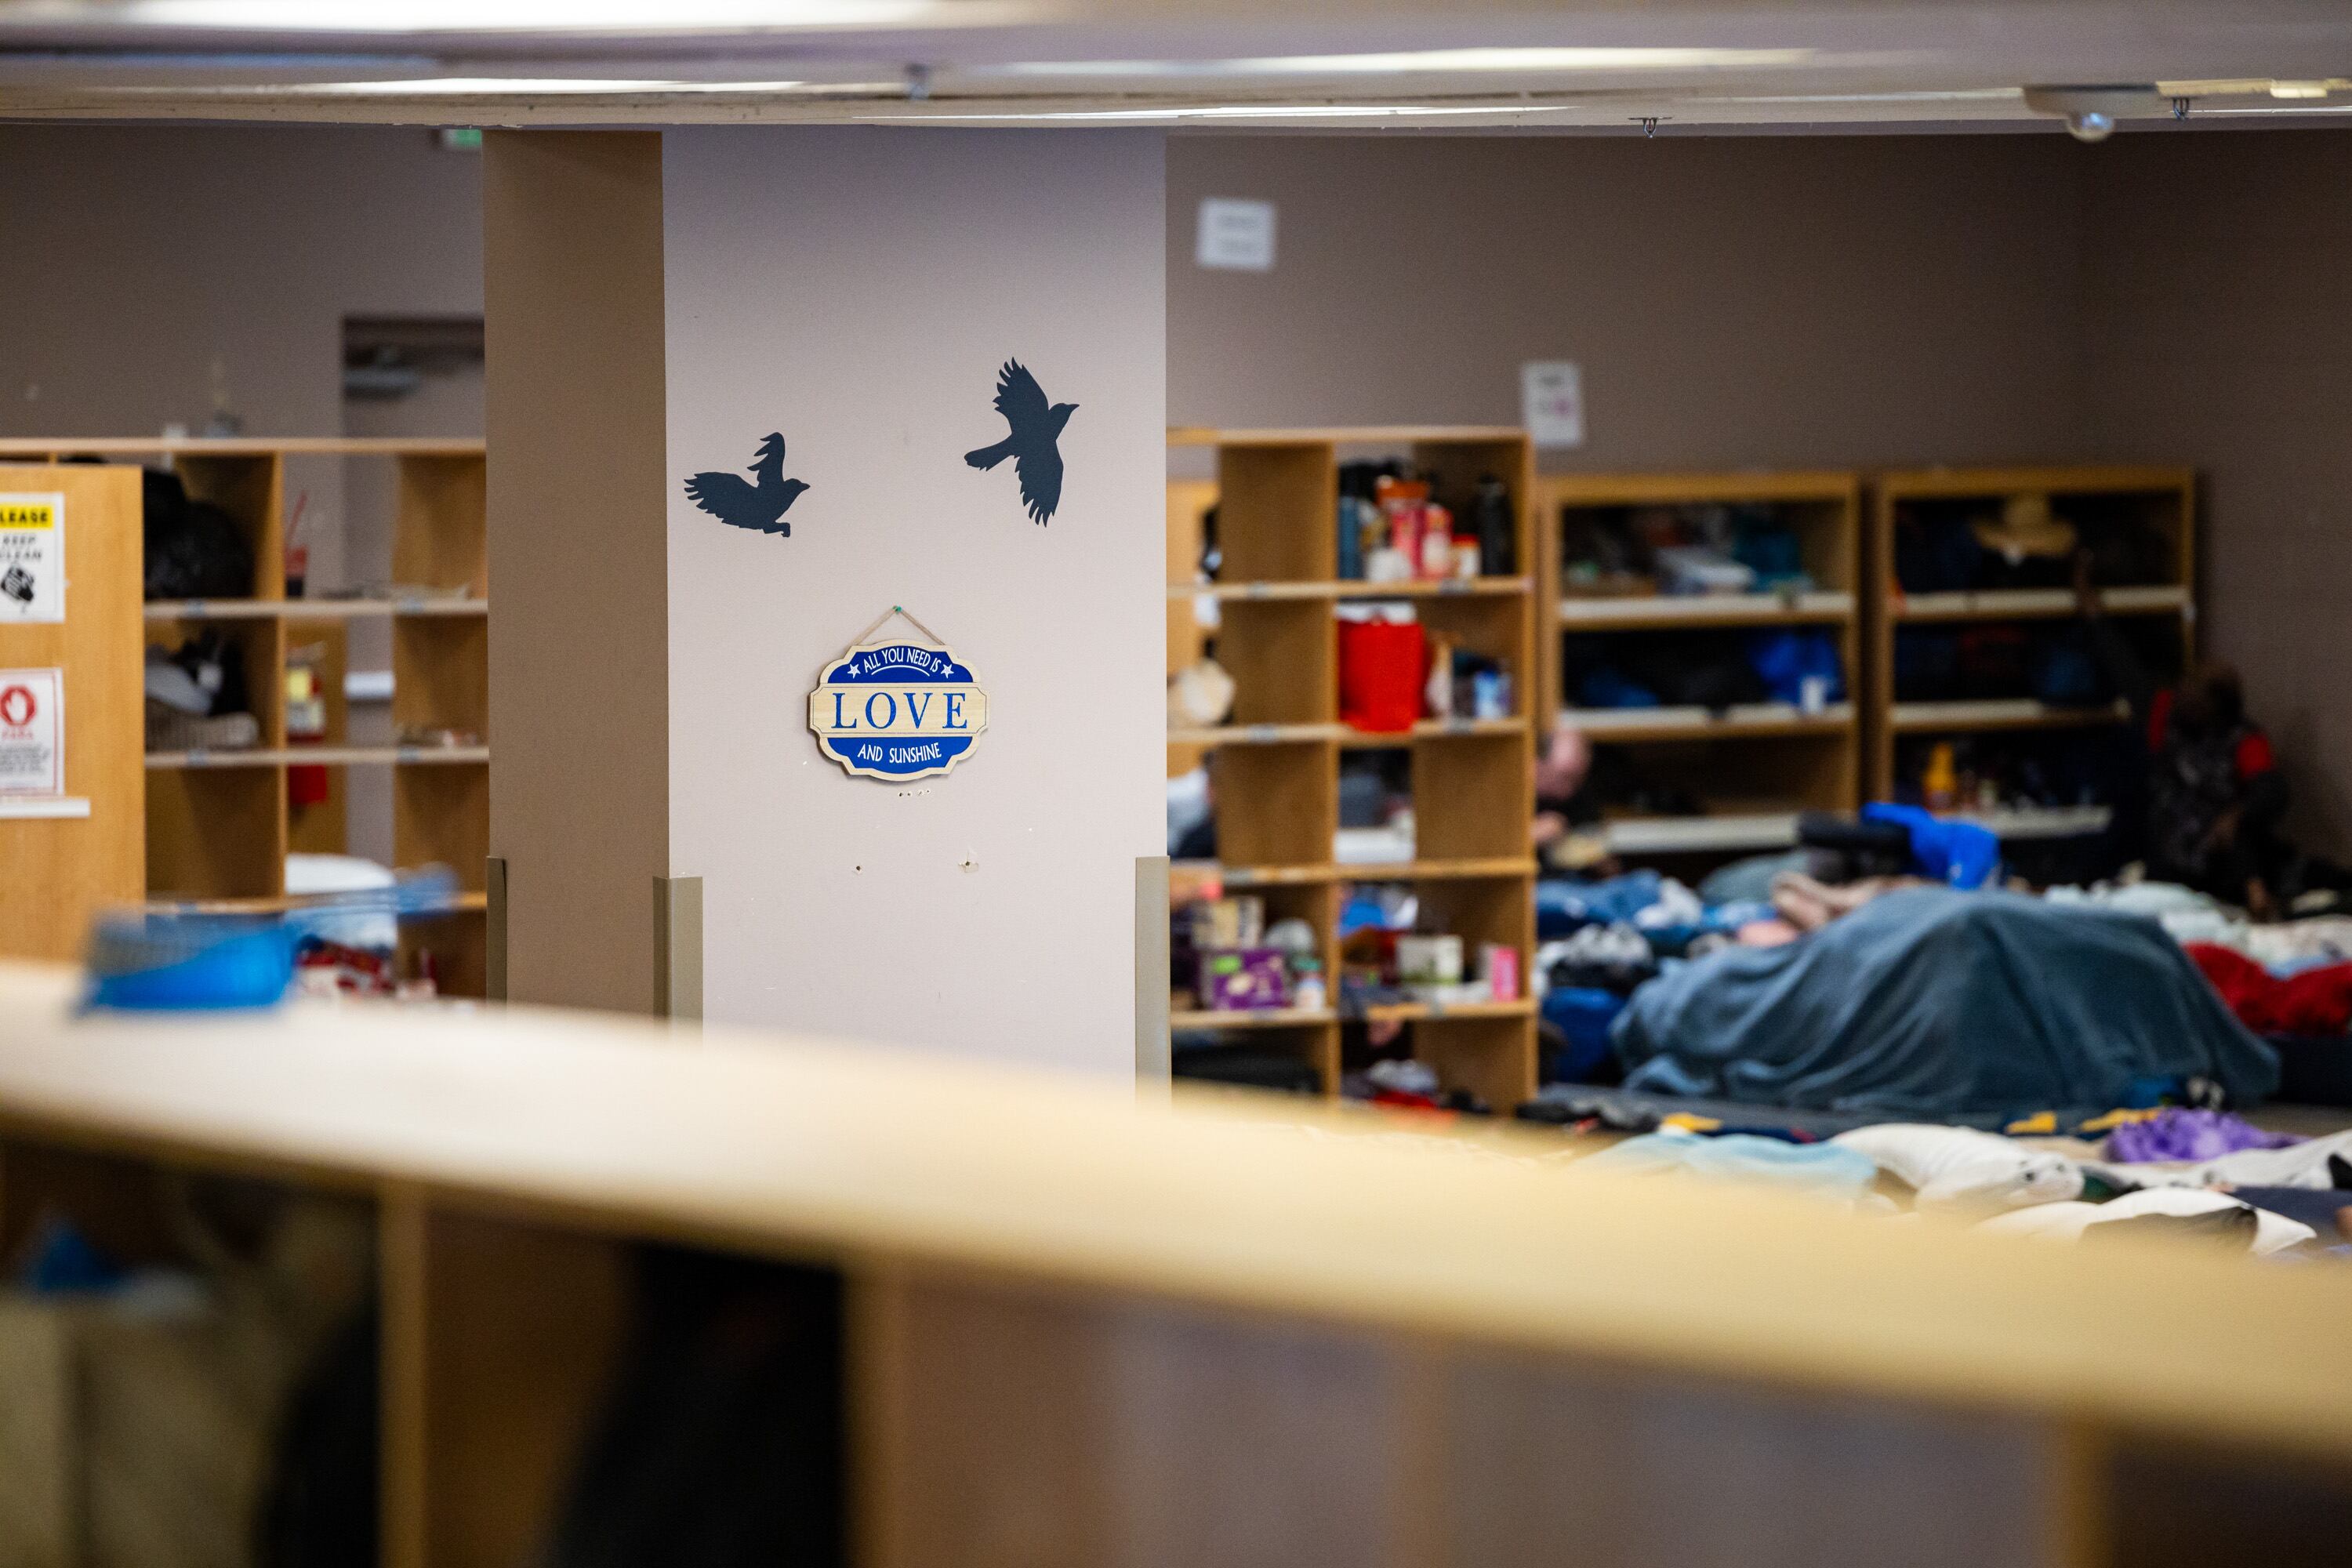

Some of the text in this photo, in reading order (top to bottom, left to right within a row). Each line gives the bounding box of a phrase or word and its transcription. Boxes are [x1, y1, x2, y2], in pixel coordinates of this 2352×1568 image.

[863, 648, 942, 673] ALL YOU NEED IS
[830, 692, 967, 729] LOVE
[857, 742, 942, 764] AND SUNSHINE
